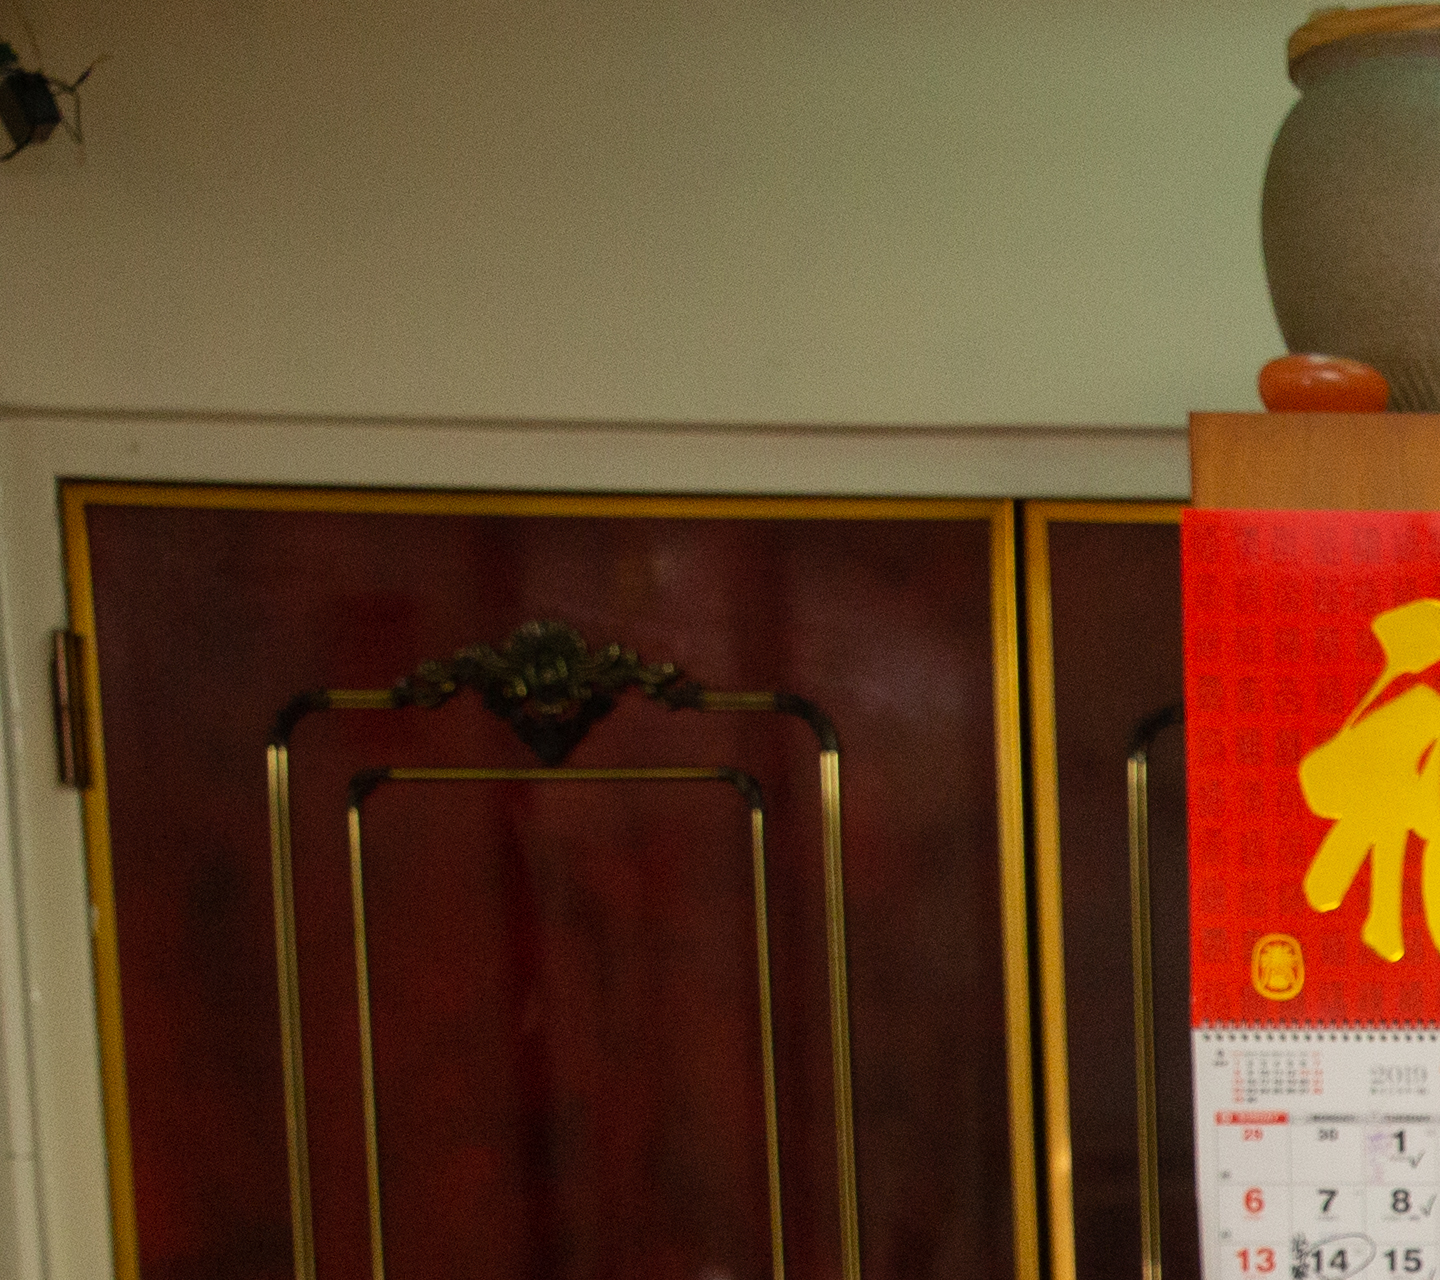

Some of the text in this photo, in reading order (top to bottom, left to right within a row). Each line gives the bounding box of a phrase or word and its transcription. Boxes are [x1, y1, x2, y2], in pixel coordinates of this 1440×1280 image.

[1394, 1130, 1405, 1153] 1
[1244, 1188, 1265, 1214] 6
[1318, 1189, 1337, 1214] 7
[1391, 1189, 1411, 1214] 8
[1238, 1248, 1275, 1273] 13
[1311, 1248, 1349, 1274] 14
[1385, 1248, 1422, 1273] 15
